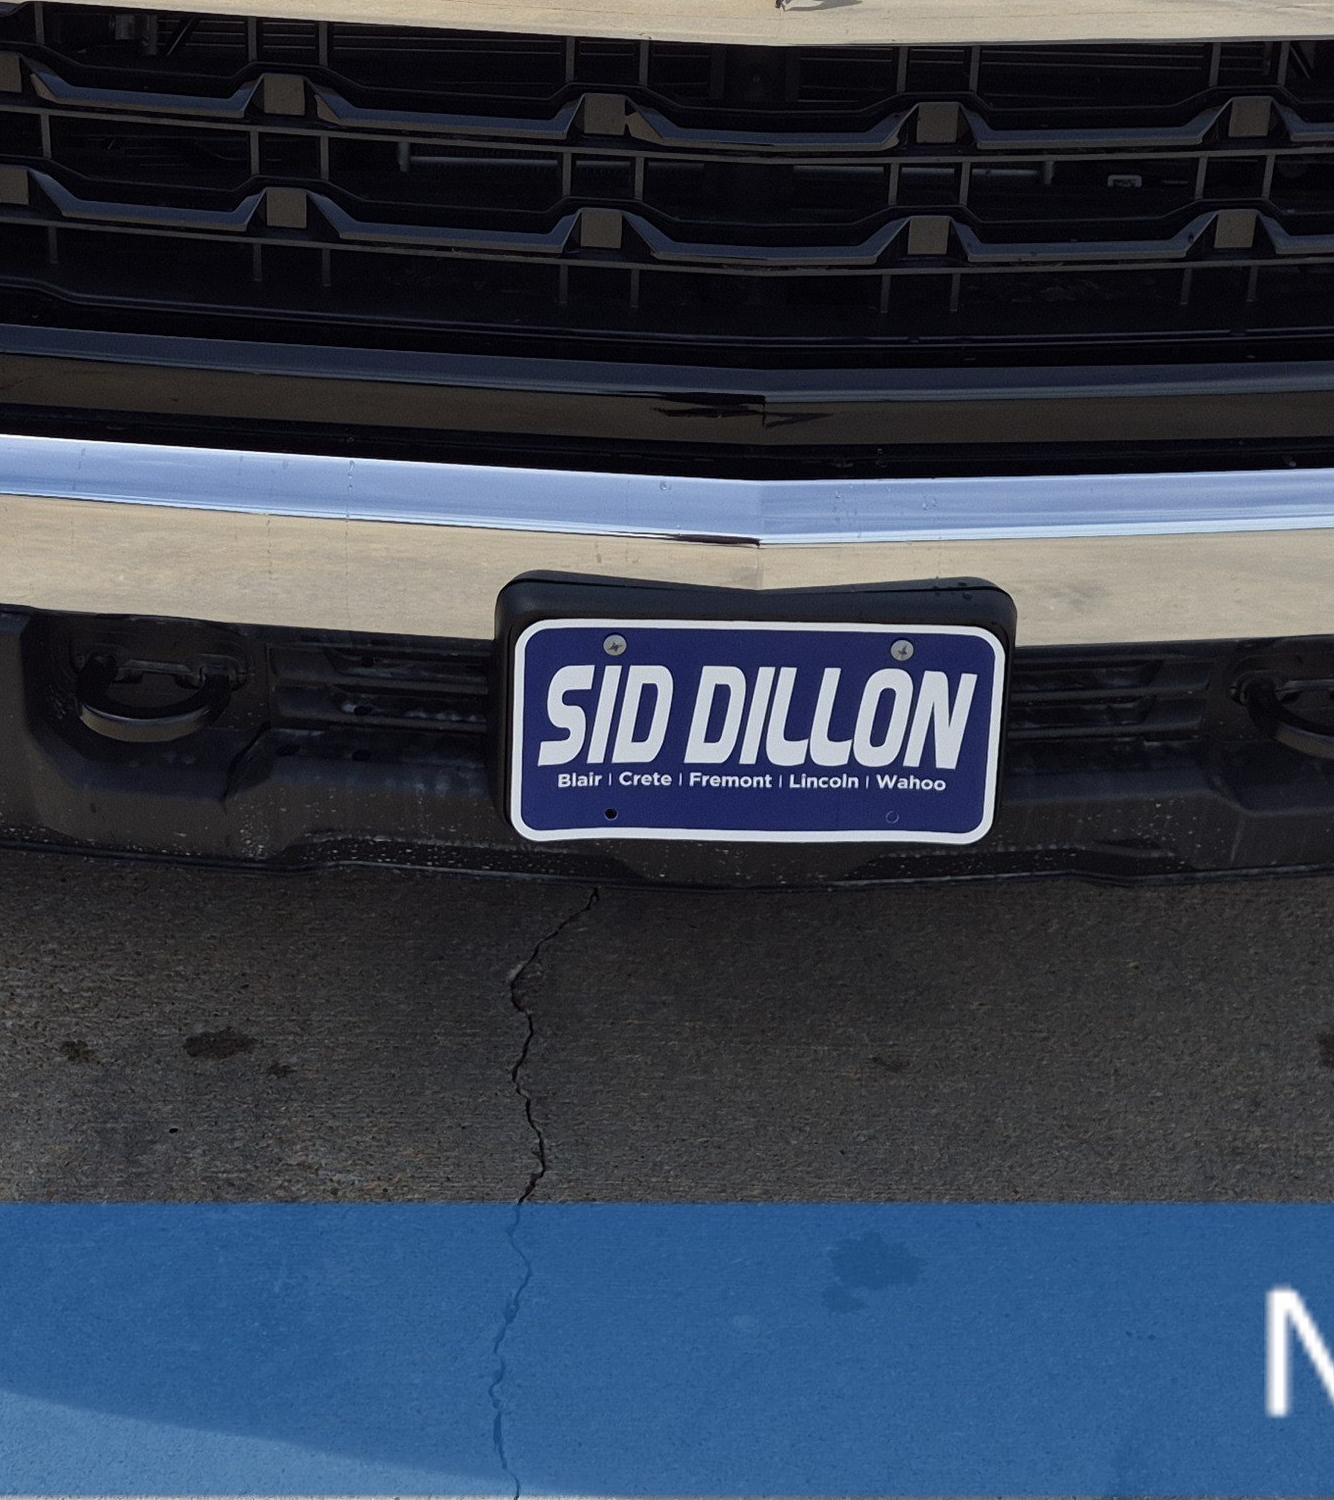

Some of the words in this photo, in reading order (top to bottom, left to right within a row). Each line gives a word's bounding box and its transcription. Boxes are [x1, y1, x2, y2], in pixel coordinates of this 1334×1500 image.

[537, 664, 674, 767] SID
[684, 665, 978, 770] DILLON
[557, 771, 603, 788] Blair
[618, 771, 673, 786] Crete
[689, 772, 773, 788] Fremont
[789, 773, 859, 789] Lincoln
[876, 774, 947, 791] Wahoo
